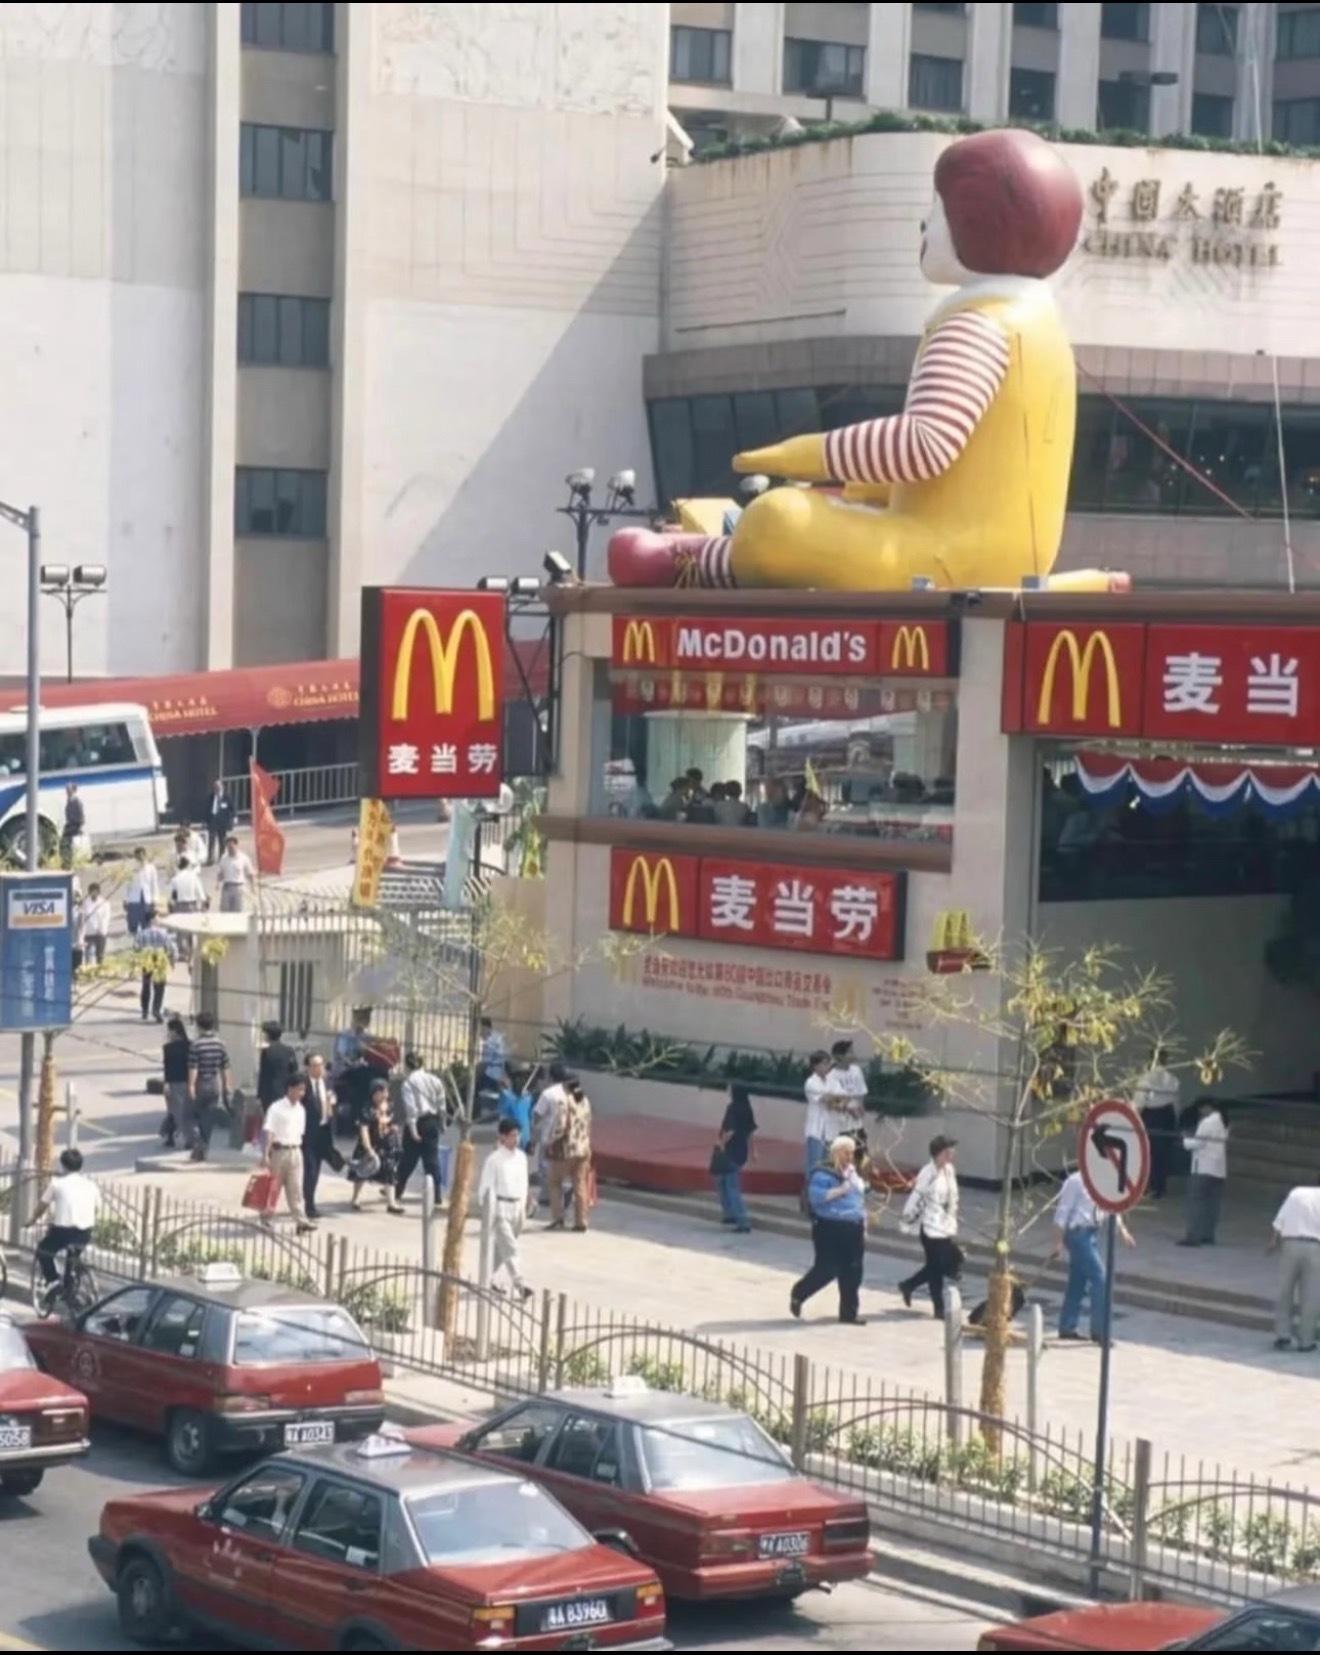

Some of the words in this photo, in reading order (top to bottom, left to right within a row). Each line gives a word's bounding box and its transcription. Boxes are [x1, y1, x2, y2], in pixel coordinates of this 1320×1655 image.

[677, 628, 867, 662] McDonald's
[1163, 652, 1299, 717] 麦当
[388, 743, 497, 774] 麦当劳
[23, 902, 55, 915] VISA
[710, 875, 878, 941] 麦当劳
